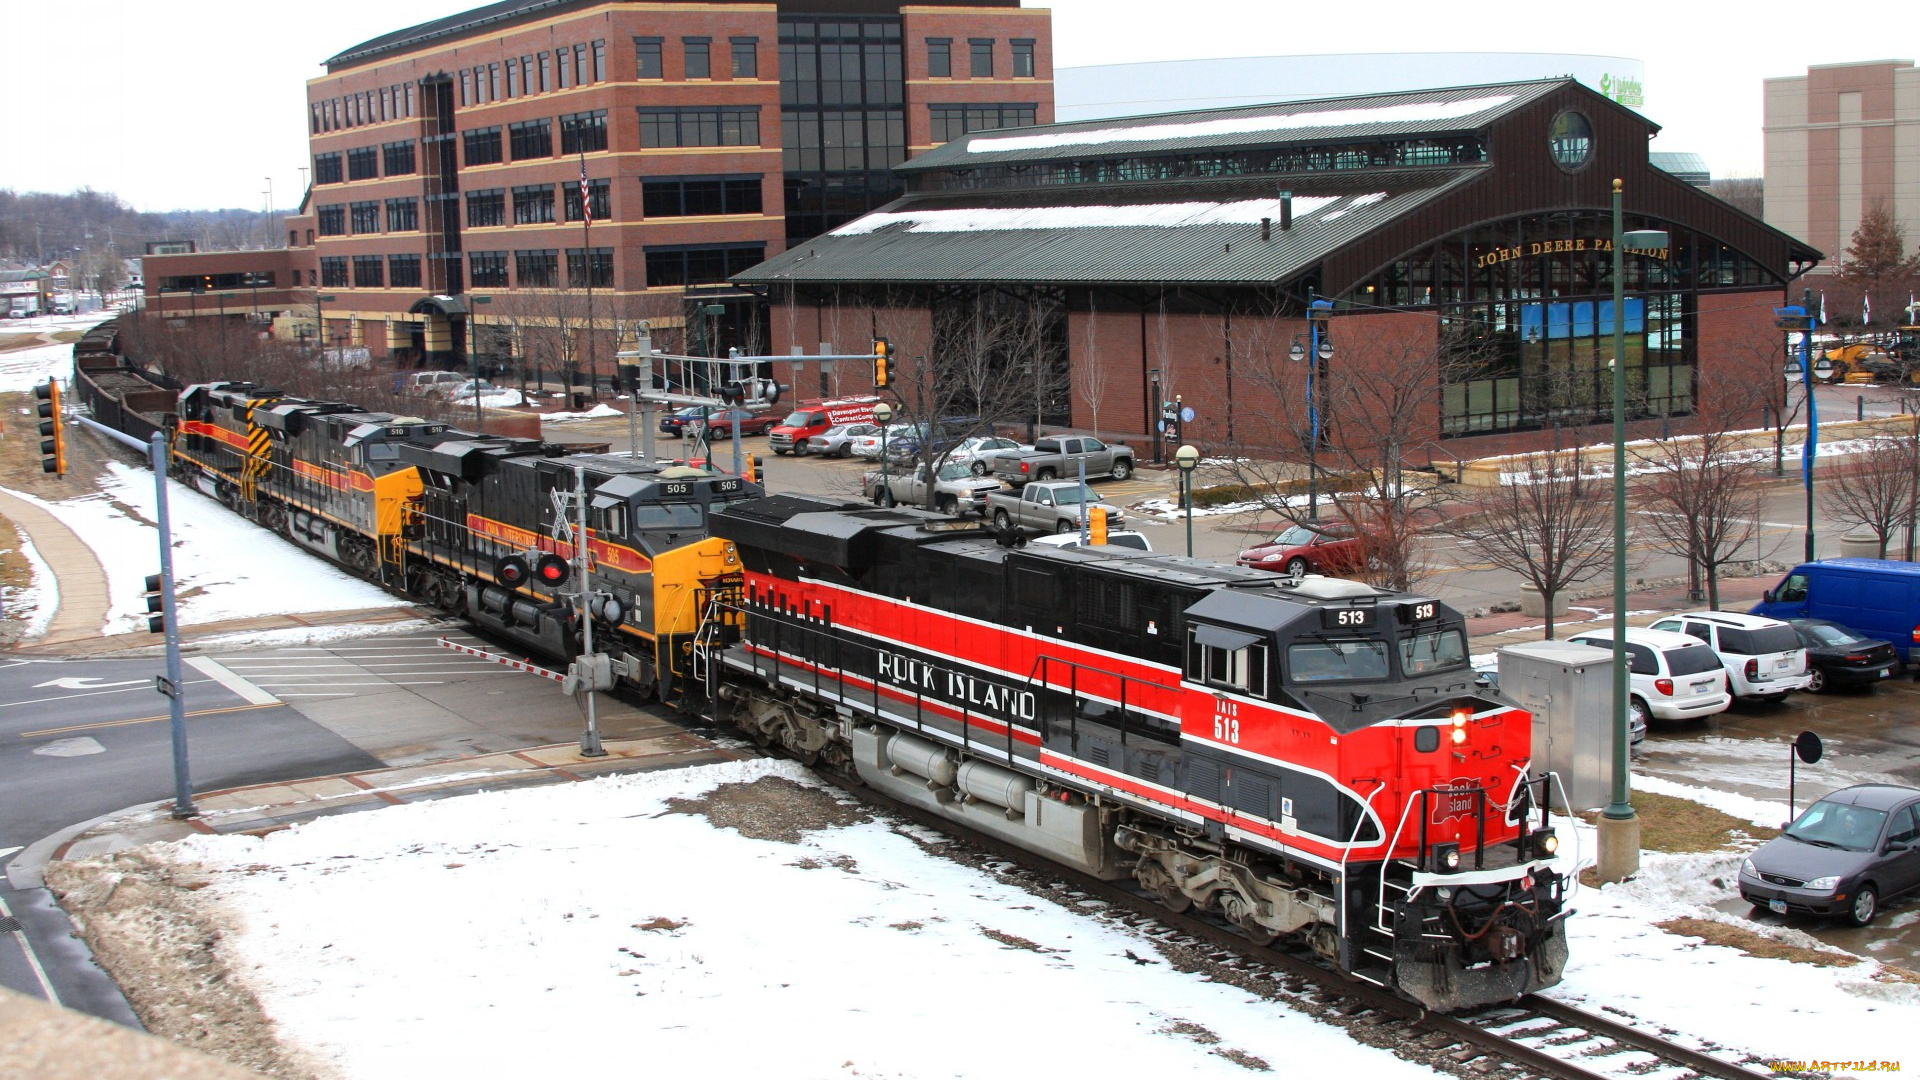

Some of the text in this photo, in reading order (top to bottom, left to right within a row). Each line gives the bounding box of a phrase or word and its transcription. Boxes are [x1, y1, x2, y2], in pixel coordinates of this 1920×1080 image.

[1478, 240, 1669, 268] JOHN DEERE PAION
[667, 484, 687, 493] 505
[721, 480, 737, 490] 505
[1338, 610, 1365, 625] 513
[1415, 603, 1434, 619] 513
[878, 649, 1035, 721] ROCK ISLAND
[1216, 699, 1238, 717] IAIS
[1214, 714, 1240, 745] 513
